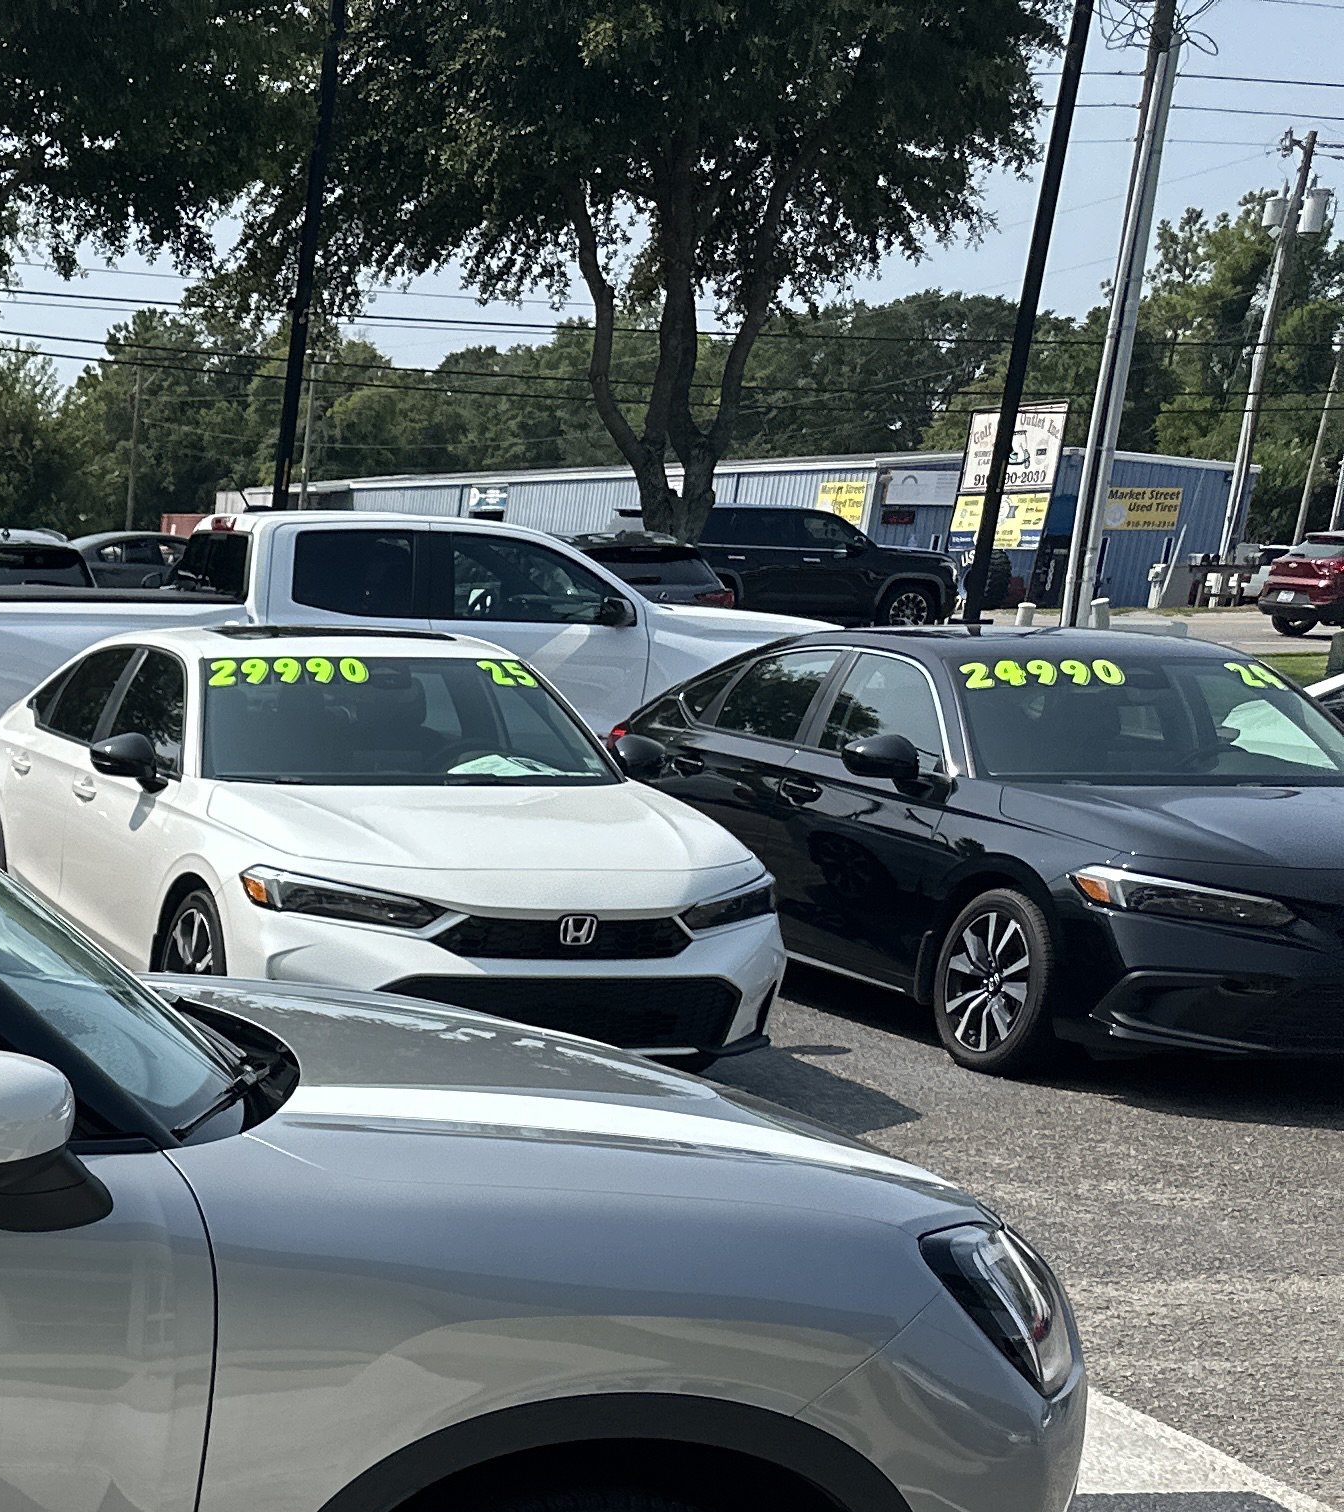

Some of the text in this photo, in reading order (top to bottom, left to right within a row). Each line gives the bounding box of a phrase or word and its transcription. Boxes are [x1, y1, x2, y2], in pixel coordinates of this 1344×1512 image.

[973, 422, 992, 445] Golf
[1020, 413, 1046, 430] Outlet
[1108, 489, 1181, 500] Market Street
[1128, 502, 1178, 512] Used Tires
[208, 657, 539, 688] 29990 25
[959, 659, 1126, 689] 24990
